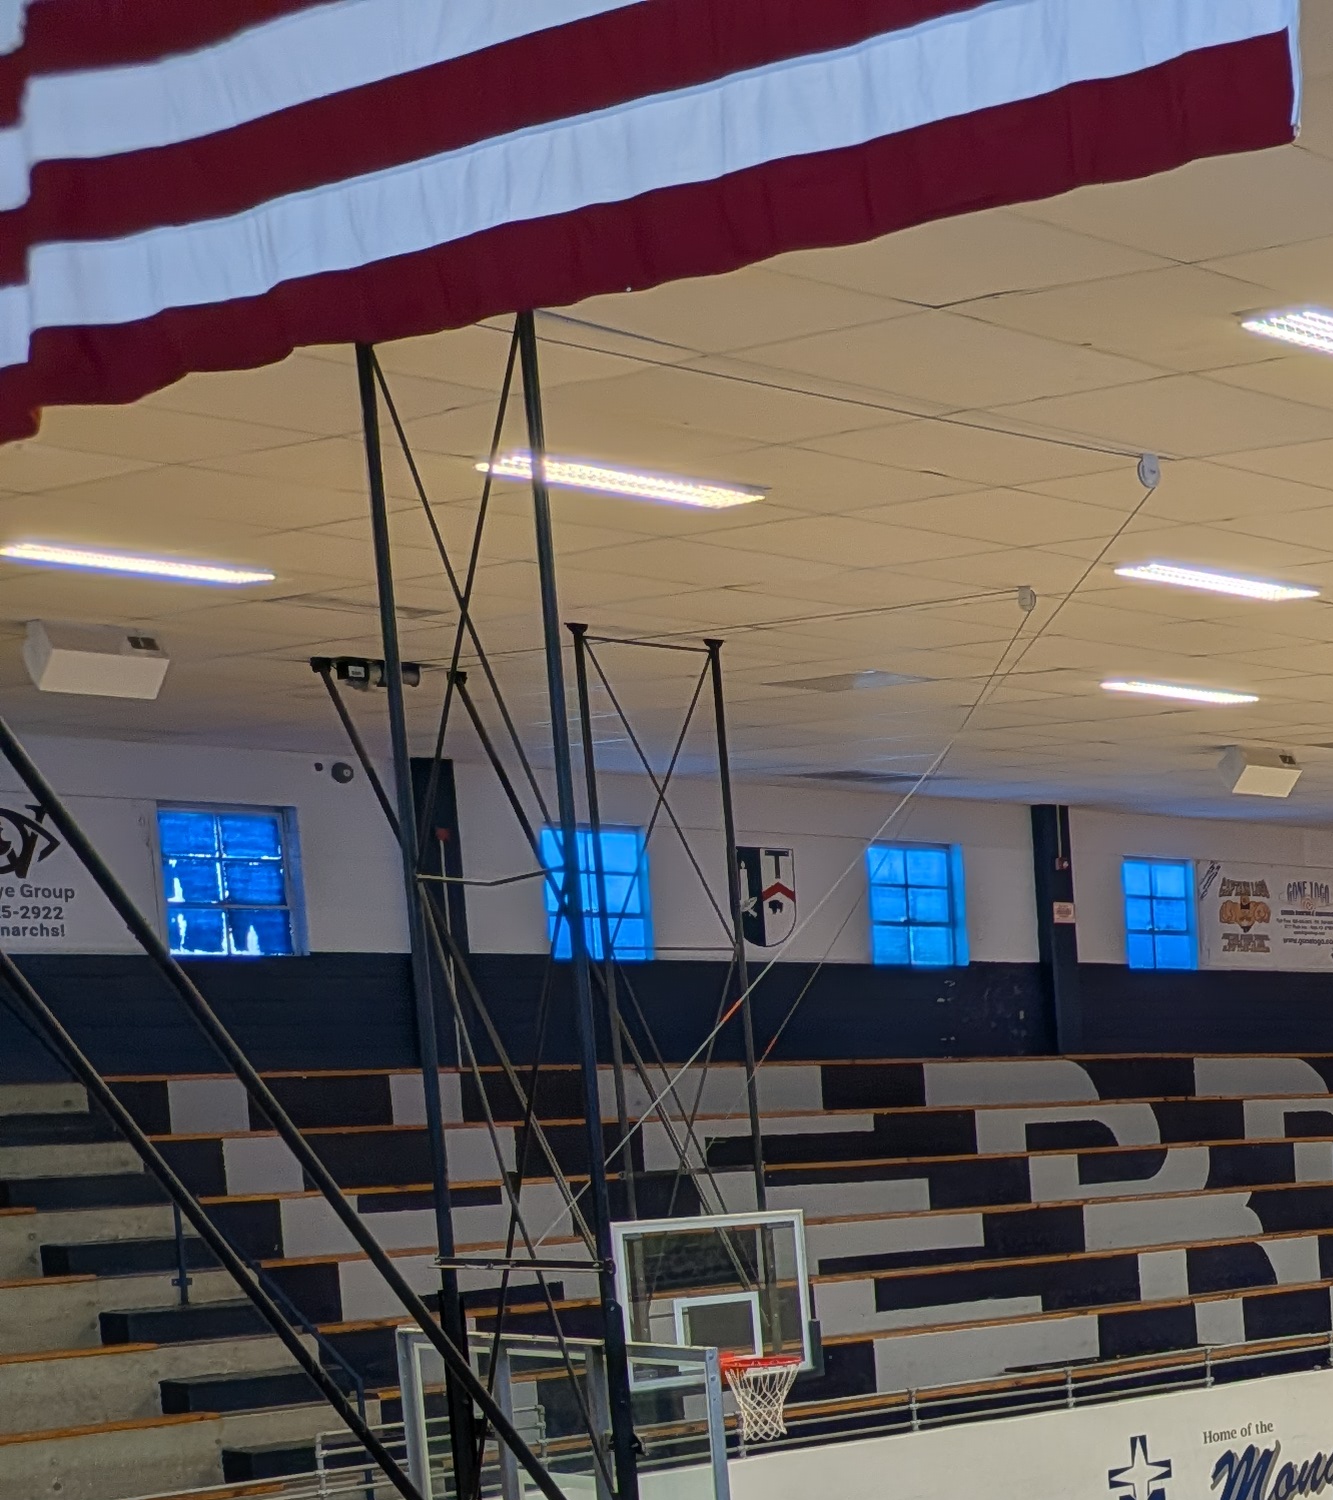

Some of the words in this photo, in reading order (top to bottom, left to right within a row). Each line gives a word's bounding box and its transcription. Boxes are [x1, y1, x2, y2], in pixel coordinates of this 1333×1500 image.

[20, 884, 75, 902] Group
[1202, 1428, 1237, 1445] Home
[1240, 1423, 1253, 1437] of
[1255, 1420, 1274, 1435] the
